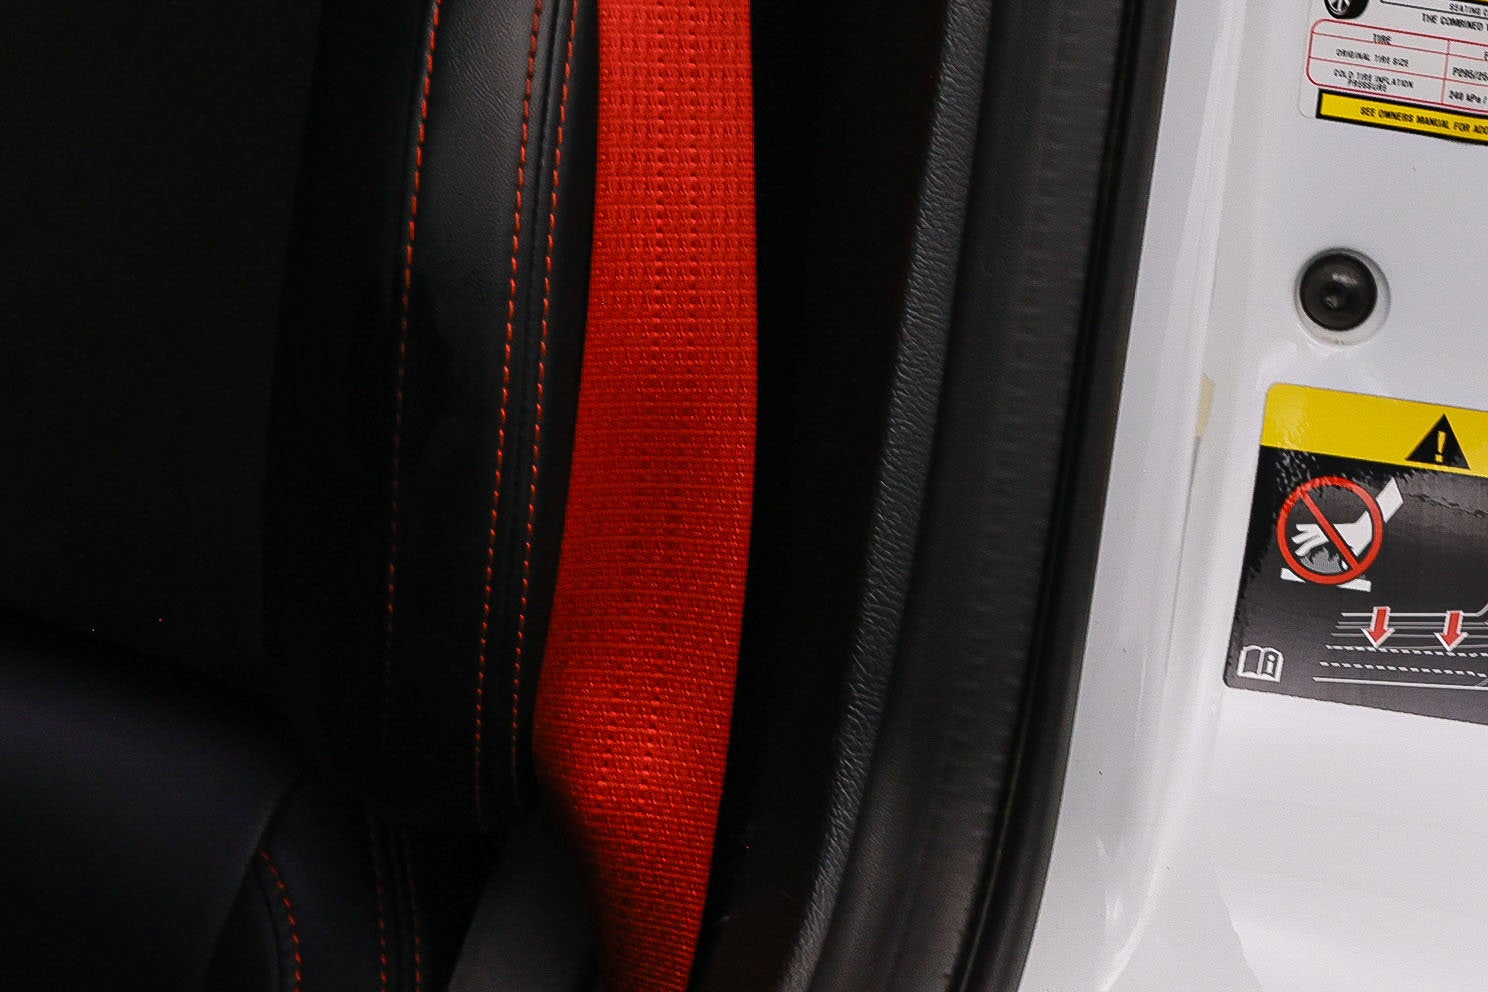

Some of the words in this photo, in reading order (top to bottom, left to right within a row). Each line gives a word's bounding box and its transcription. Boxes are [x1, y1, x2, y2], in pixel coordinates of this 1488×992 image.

[1360, 106, 1376, 117] SEE
[1416, 115, 1450, 129] MANUAL
[1454, 121, 1471, 133] FOR
